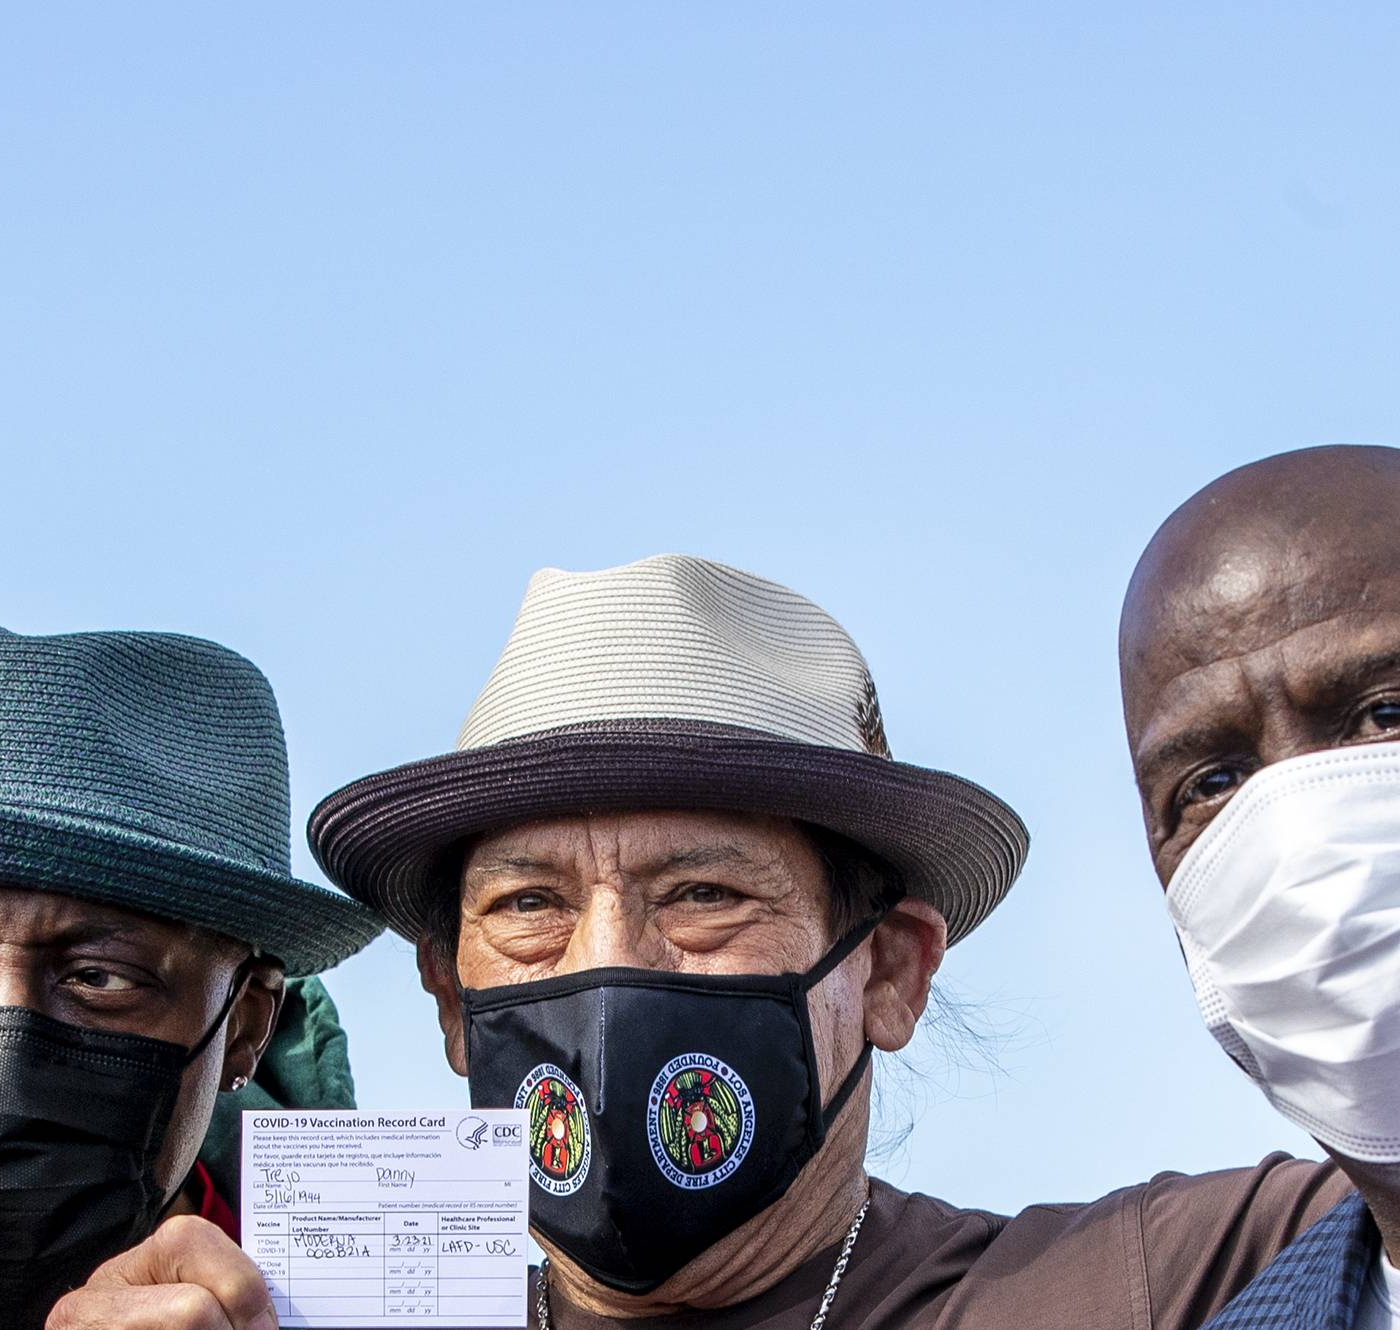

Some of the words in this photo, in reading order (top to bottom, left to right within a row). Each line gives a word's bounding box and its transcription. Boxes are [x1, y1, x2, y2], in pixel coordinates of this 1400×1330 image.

[668, 1055, 719, 1073] FOUNDED
[653, 1071, 669, 1095] 1886
[728, 1073, 747, 1097] LOS
[253, 1117, 307, 1128] COVID-19
[310, 1117, 375, 1128] Vaccination
[378, 1117, 417, 1128] Record
[420, 1117, 446, 1128] Card
[494, 1126, 520, 1138] CDC
[734, 1100, 754, 1159] ANGELES
[649, 1108, 684, 1185] DEPARTMENT
[260, 1168, 301, 1191] Trejo
[376, 1167, 415, 1189] Danny
[712, 1160, 736, 1182] CITY
[552, 1180, 571, 1193] CITY
[685, 1177, 709, 1187] FIRE
[486, 1239, 516, 1256] USC
